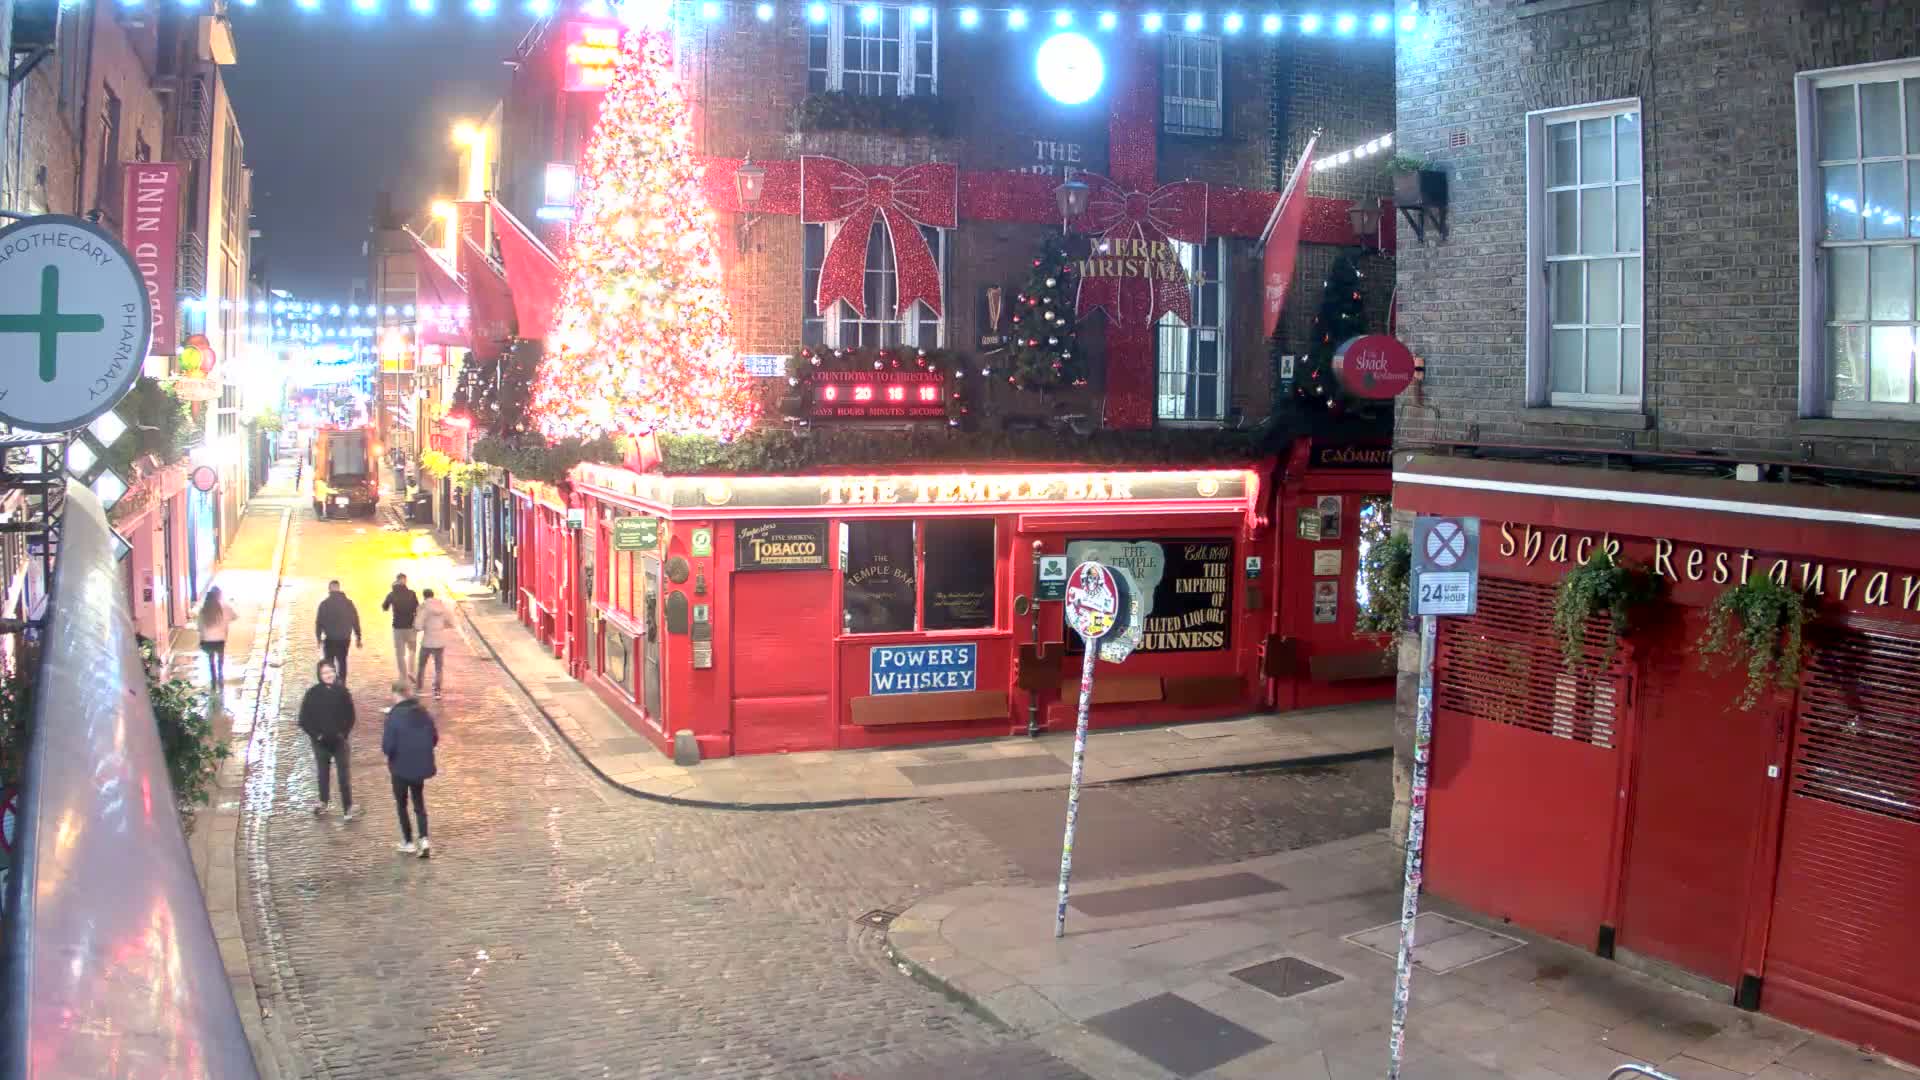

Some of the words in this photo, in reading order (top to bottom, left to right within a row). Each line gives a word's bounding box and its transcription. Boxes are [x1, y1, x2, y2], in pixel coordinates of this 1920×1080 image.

[1033, 141, 1081, 162] THE
[136, 171, 168, 231] NINE
[1090, 238, 1179, 261] MERRY
[89, 303, 136, 400] PHARMACY
[811, 371, 874, 383] COUNTDOWN
[875, 372, 889, 382] TO
[889, 372, 945, 383] CHRISTMAS
[825, 386, 836, 401] 0
[838, 407, 865, 416] HOURS
[869, 407, 905, 416] MINUTES
[909, 407, 944, 416] SECONDS
[820, 477, 897, 503] THE
[912, 475, 1048, 503] TEMPLE
[1064, 473, 1134, 500] BAR
[748, 538, 816, 561] TOBACCO
[1122, 546, 1146, 558] THE
[1500, 520, 1620, 566] Shack
[1111, 557, 1157, 568] TEMPLE
[1203, 563, 1226, 578] THE
[848, 565, 890, 587] TEMPLE
[893, 568, 914, 589] BAR
[1175, 578, 1226, 593] EMPEROR
[1211, 594, 1225, 608] OF
[1421, 584, 1443, 602] 24
[1183, 608, 1226, 628] LIQUORS
[880, 648, 968, 667] POWER'S
[873, 670, 974, 690] WHISKEY
